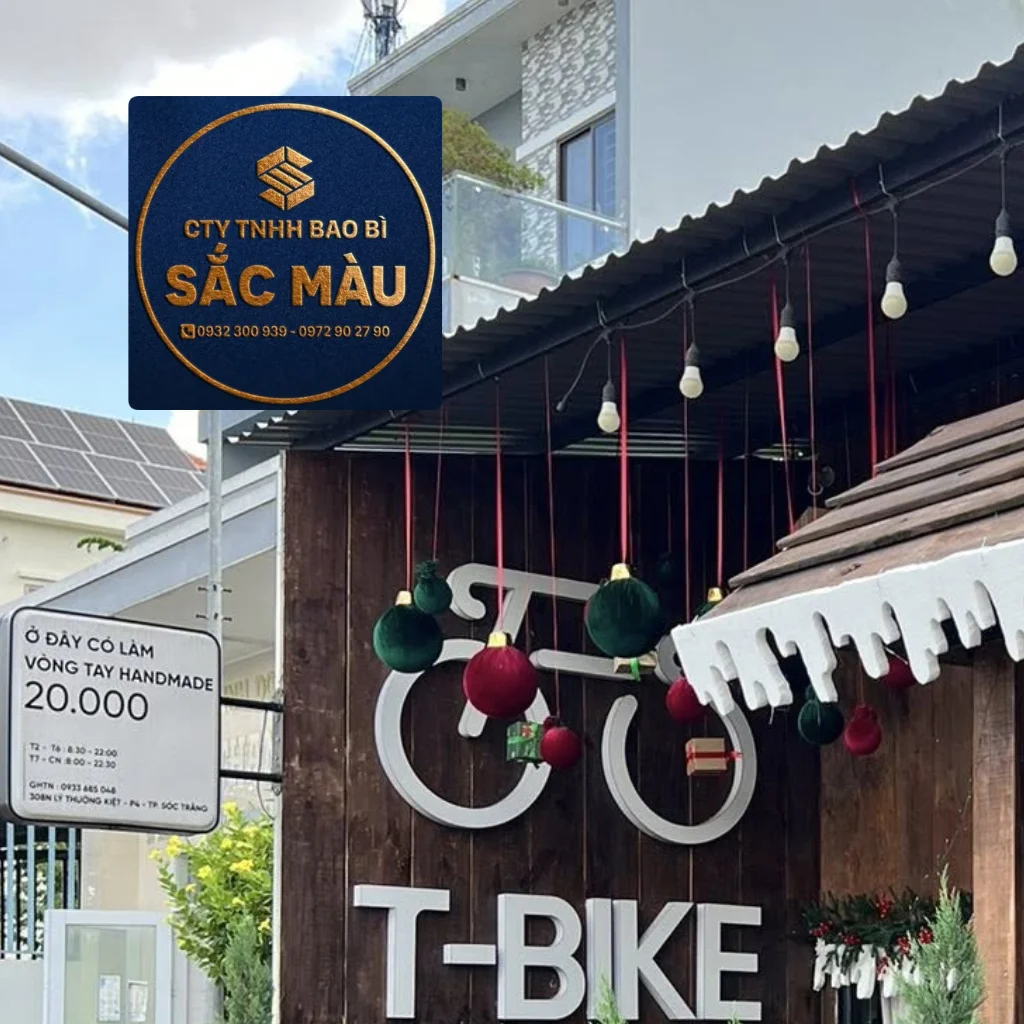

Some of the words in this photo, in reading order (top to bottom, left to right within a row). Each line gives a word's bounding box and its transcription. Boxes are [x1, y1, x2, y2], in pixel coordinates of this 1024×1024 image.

[25, 625, 40, 644] Ở
[45, 630, 82, 649] ĐÂY
[87, 636, 115, 653] CÓ
[120, 639, 154, 659] LÀM
[25, 653, 79, 674] VÒNG
[84, 662, 114, 678] TAY
[120, 667, 213, 691] HANDMADE
[24, 681, 149, 721] 20.000
[353, 884, 762, 1021] T-BIKE
